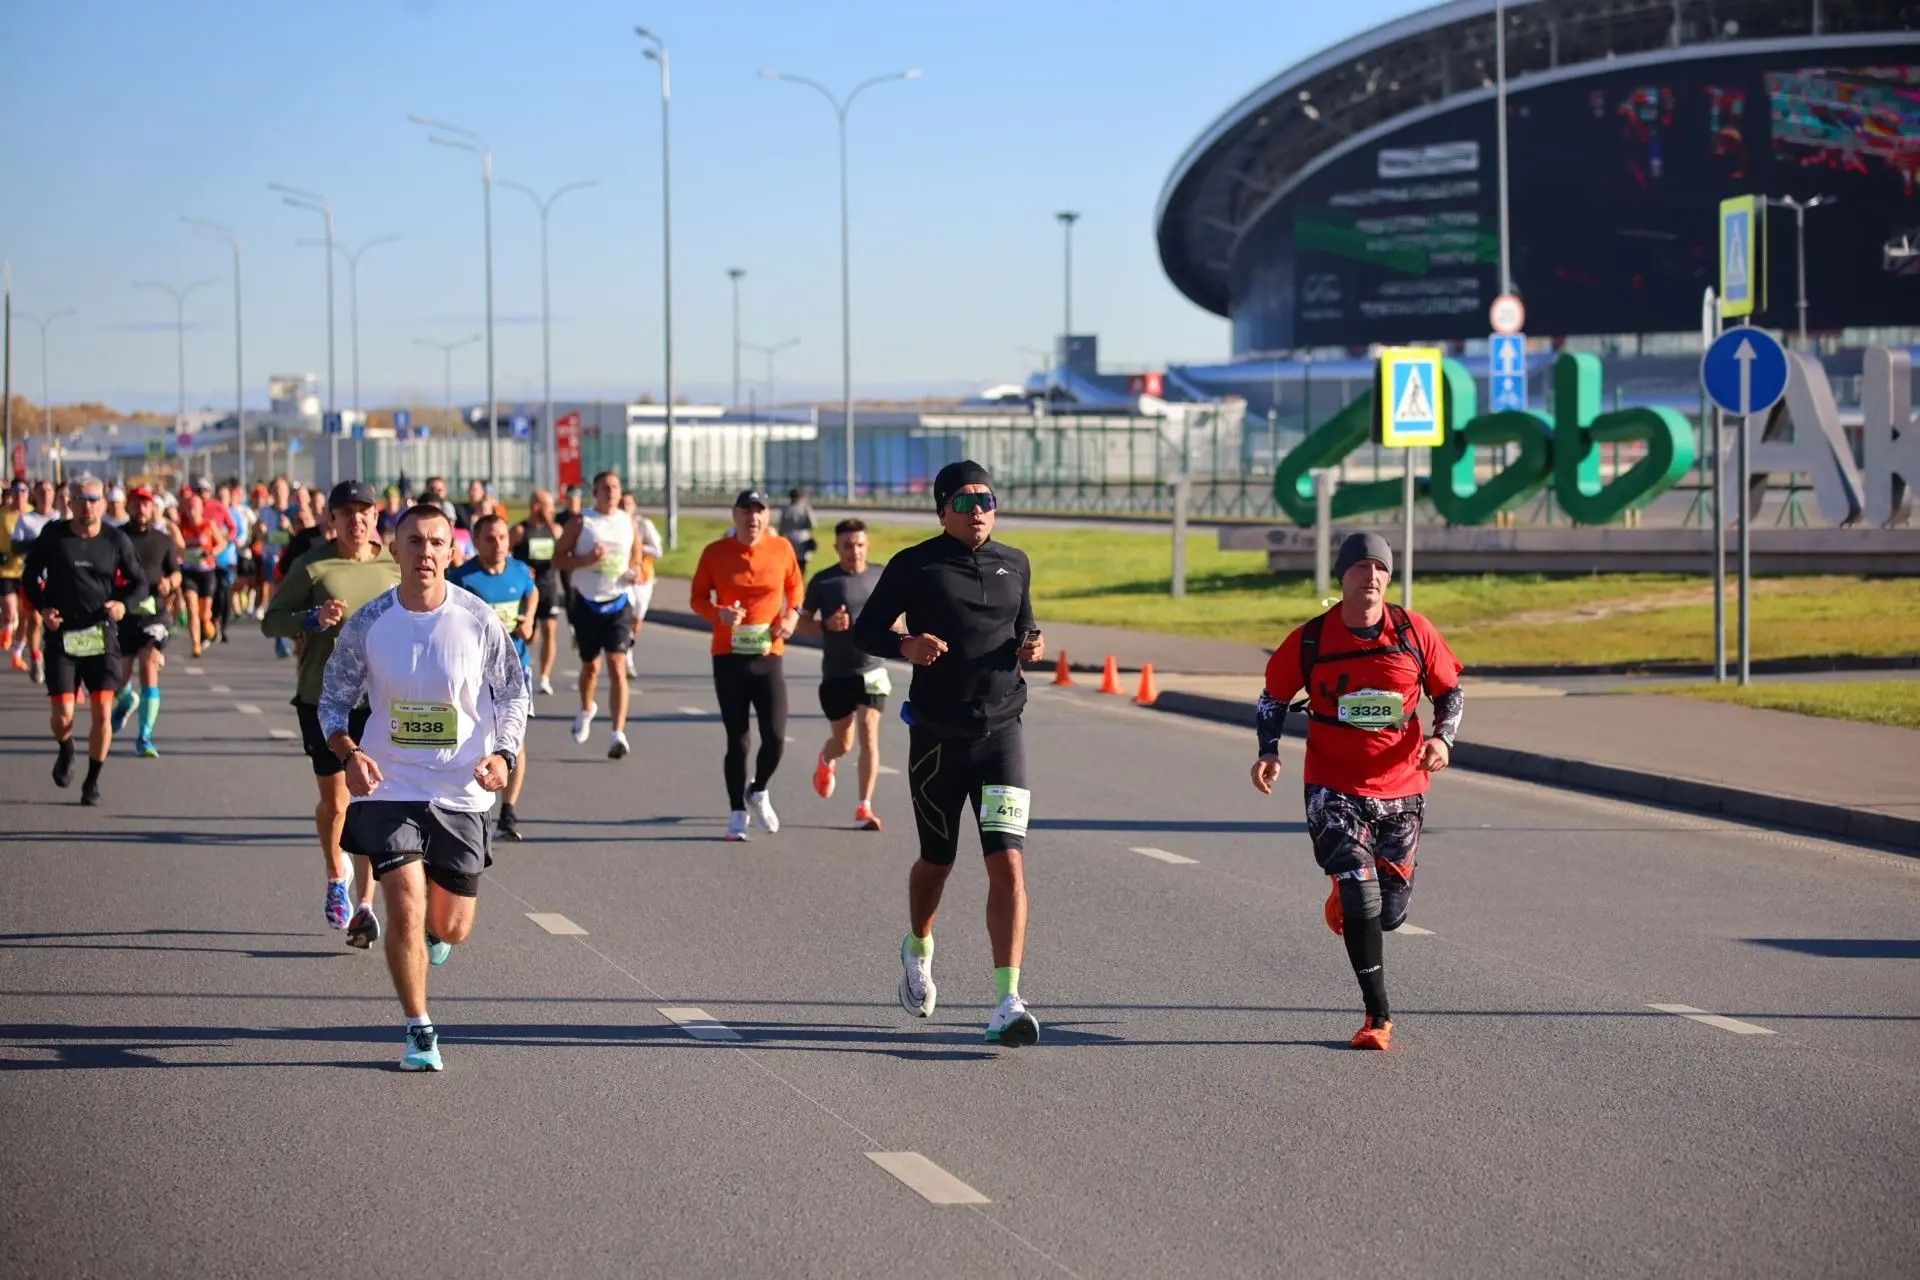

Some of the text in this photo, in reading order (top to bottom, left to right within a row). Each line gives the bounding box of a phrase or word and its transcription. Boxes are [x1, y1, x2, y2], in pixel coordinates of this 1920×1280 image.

[1340, 706, 1392, 716] C 3328
[391, 720, 444, 733] C 1338
[996, 804, 1024, 818] 416
